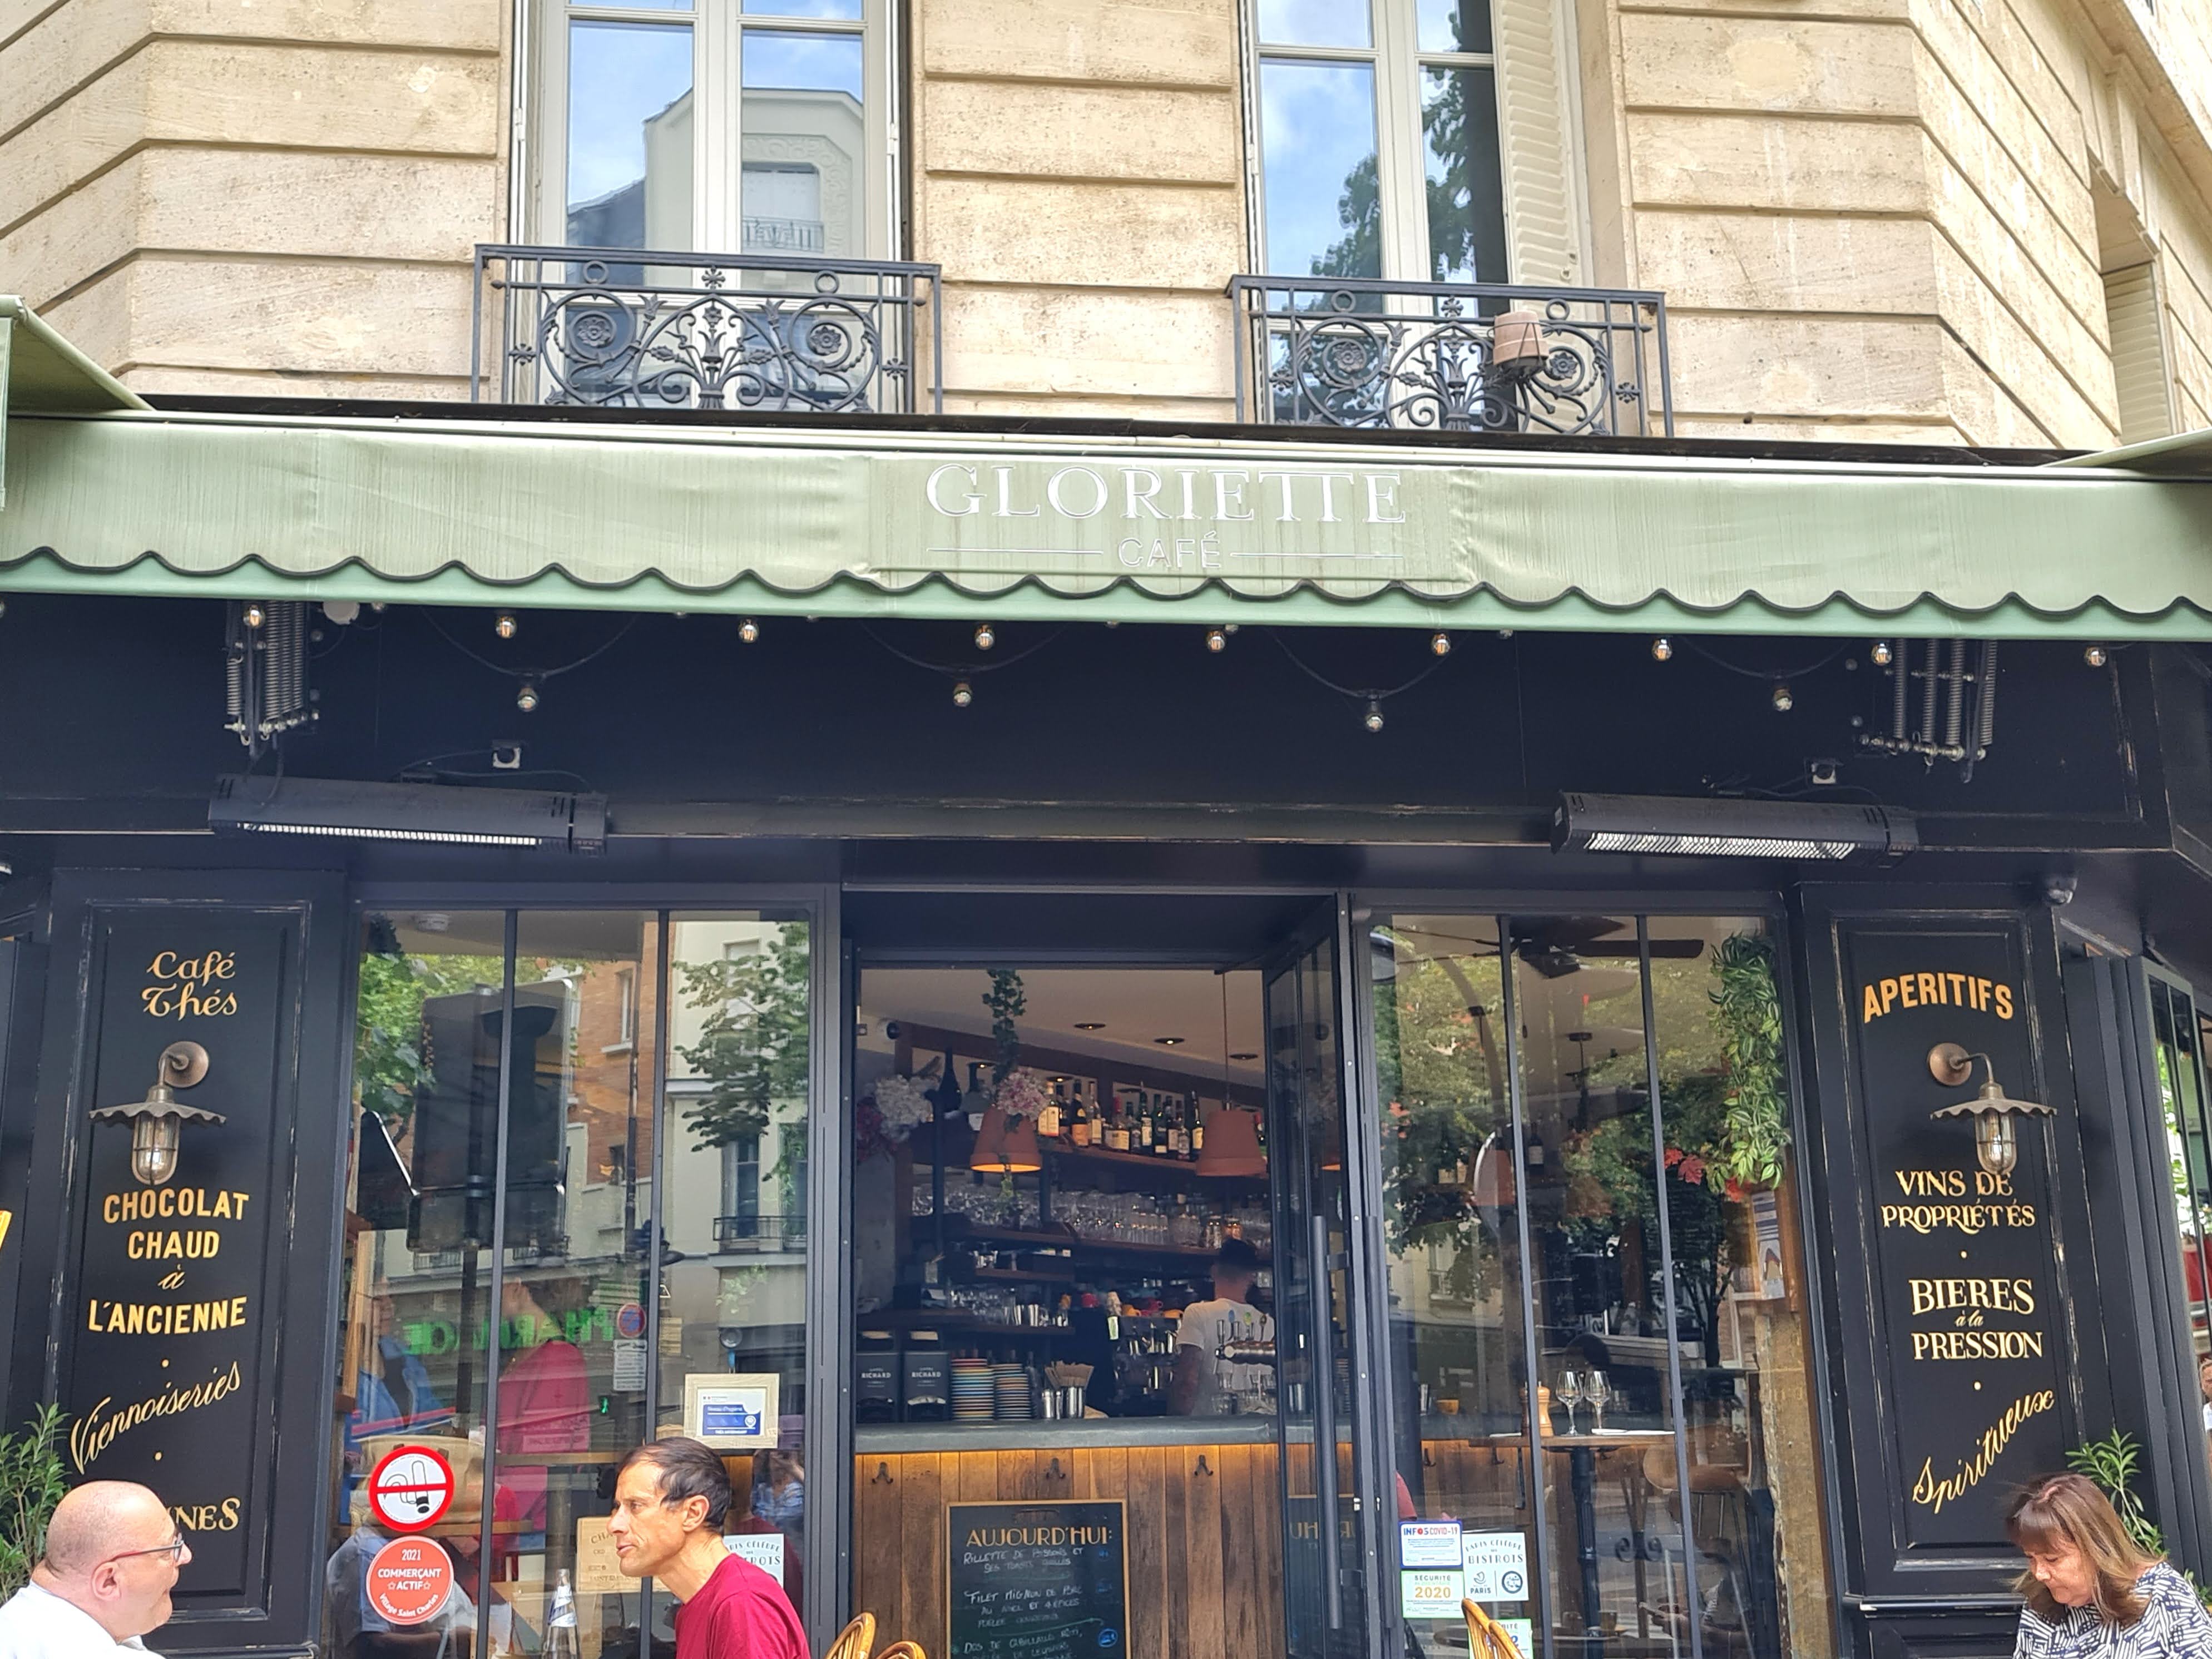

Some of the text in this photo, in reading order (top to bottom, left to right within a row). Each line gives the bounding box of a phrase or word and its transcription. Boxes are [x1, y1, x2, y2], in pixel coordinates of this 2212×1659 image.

[926, 463, 1406, 523] GLORIETTE
[1117, 531, 1221, 569] CAFÉ
[146, 951, 235, 986] Café
[141, 982, 237, 1021] Thés
[1864, 972, 2013, 1024] APERITIFS
[1895, 1170, 2013, 1197] VINS DE
[103, 1187, 250, 1224] CHOCOLAT
[1881, 1197, 2036, 1235] PROPRIÉTÉS
[128, 1230, 220, 1259] CHAUD
[157, 1264, 185, 1290] à
[1908, 1279, 2035, 1315] BIERES
[88, 1296, 247, 1334] L'ANCIENNE
[1911, 1331, 2042, 1360] PRESSION
[70, 1360, 241, 1475] Viennoiseries
[1429, 1527, 1457, 1535] COVID-19
[402, 1549, 421, 1561] 2021
[378, 1568, 442, 1579] COMMERÇANT
[397, 1580, 424, 1590] ACTIF
[379, 1592, 398, 1614] Village
[397, 1608, 417, 1617] Saint
[1415, 1586, 1451, 1598] 2020
